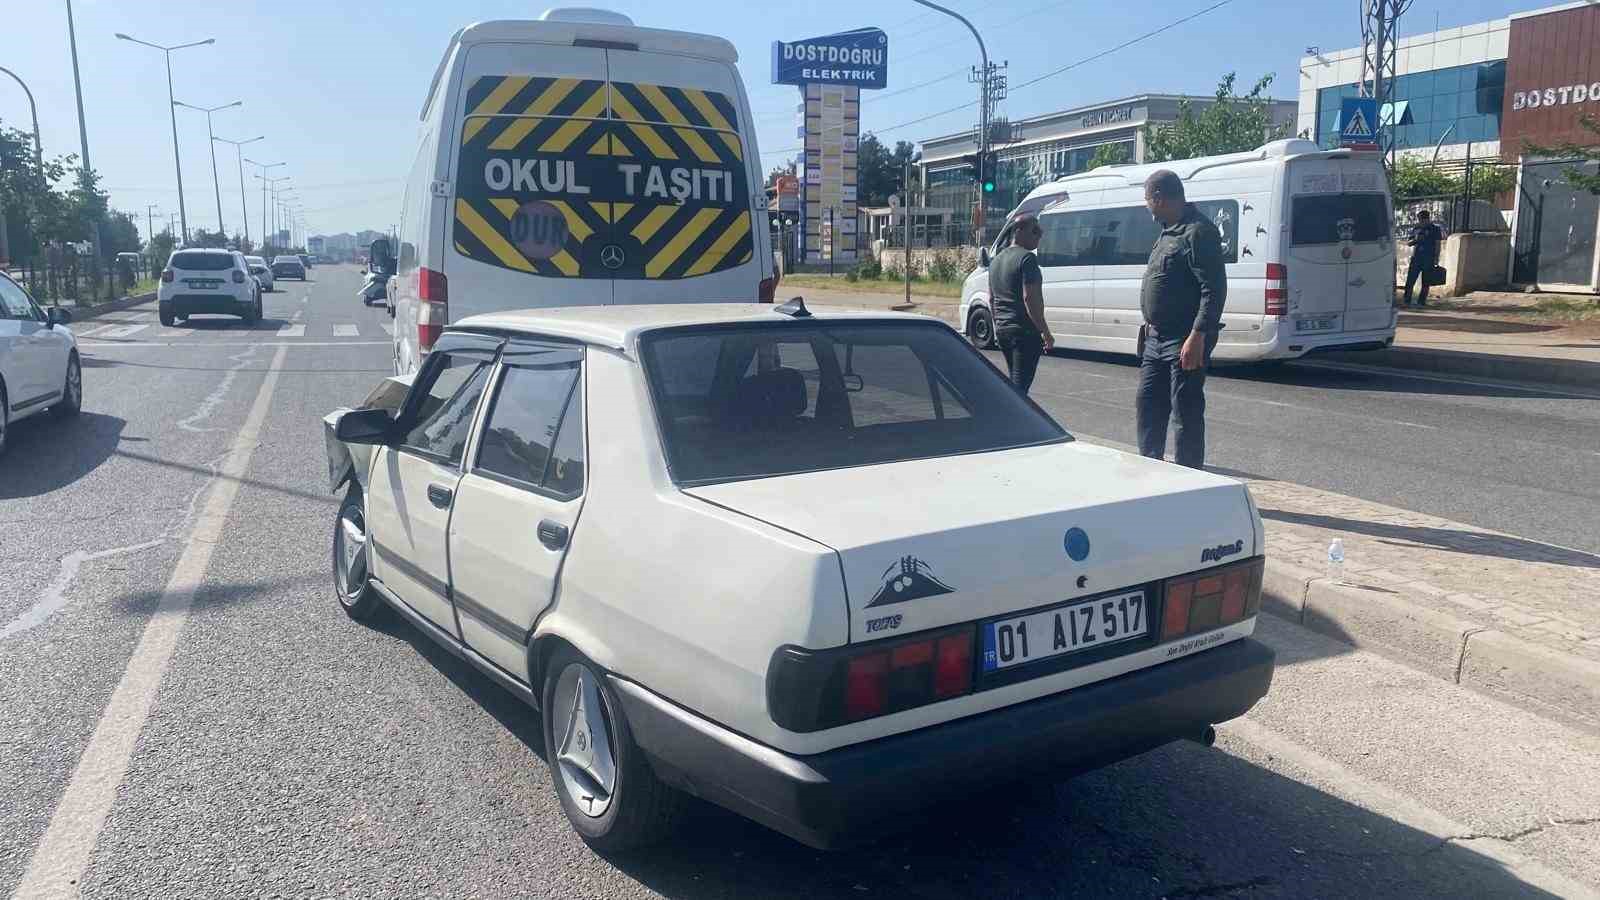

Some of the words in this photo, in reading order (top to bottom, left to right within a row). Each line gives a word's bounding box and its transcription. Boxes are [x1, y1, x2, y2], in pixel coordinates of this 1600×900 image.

[783, 43, 882, 65] DOSTDOĞRU
[802, 68, 876, 80] ELEKTRİK
[484, 158, 591, 194] OKUL
[618, 163, 733, 206] TAŞITI
[514, 213, 567, 246] DUR
[998, 621, 1028, 662] 01
[1053, 606, 1097, 650] AIZ
[1102, 595, 1144, 637] 517
[984, 651, 996, 663] TR
